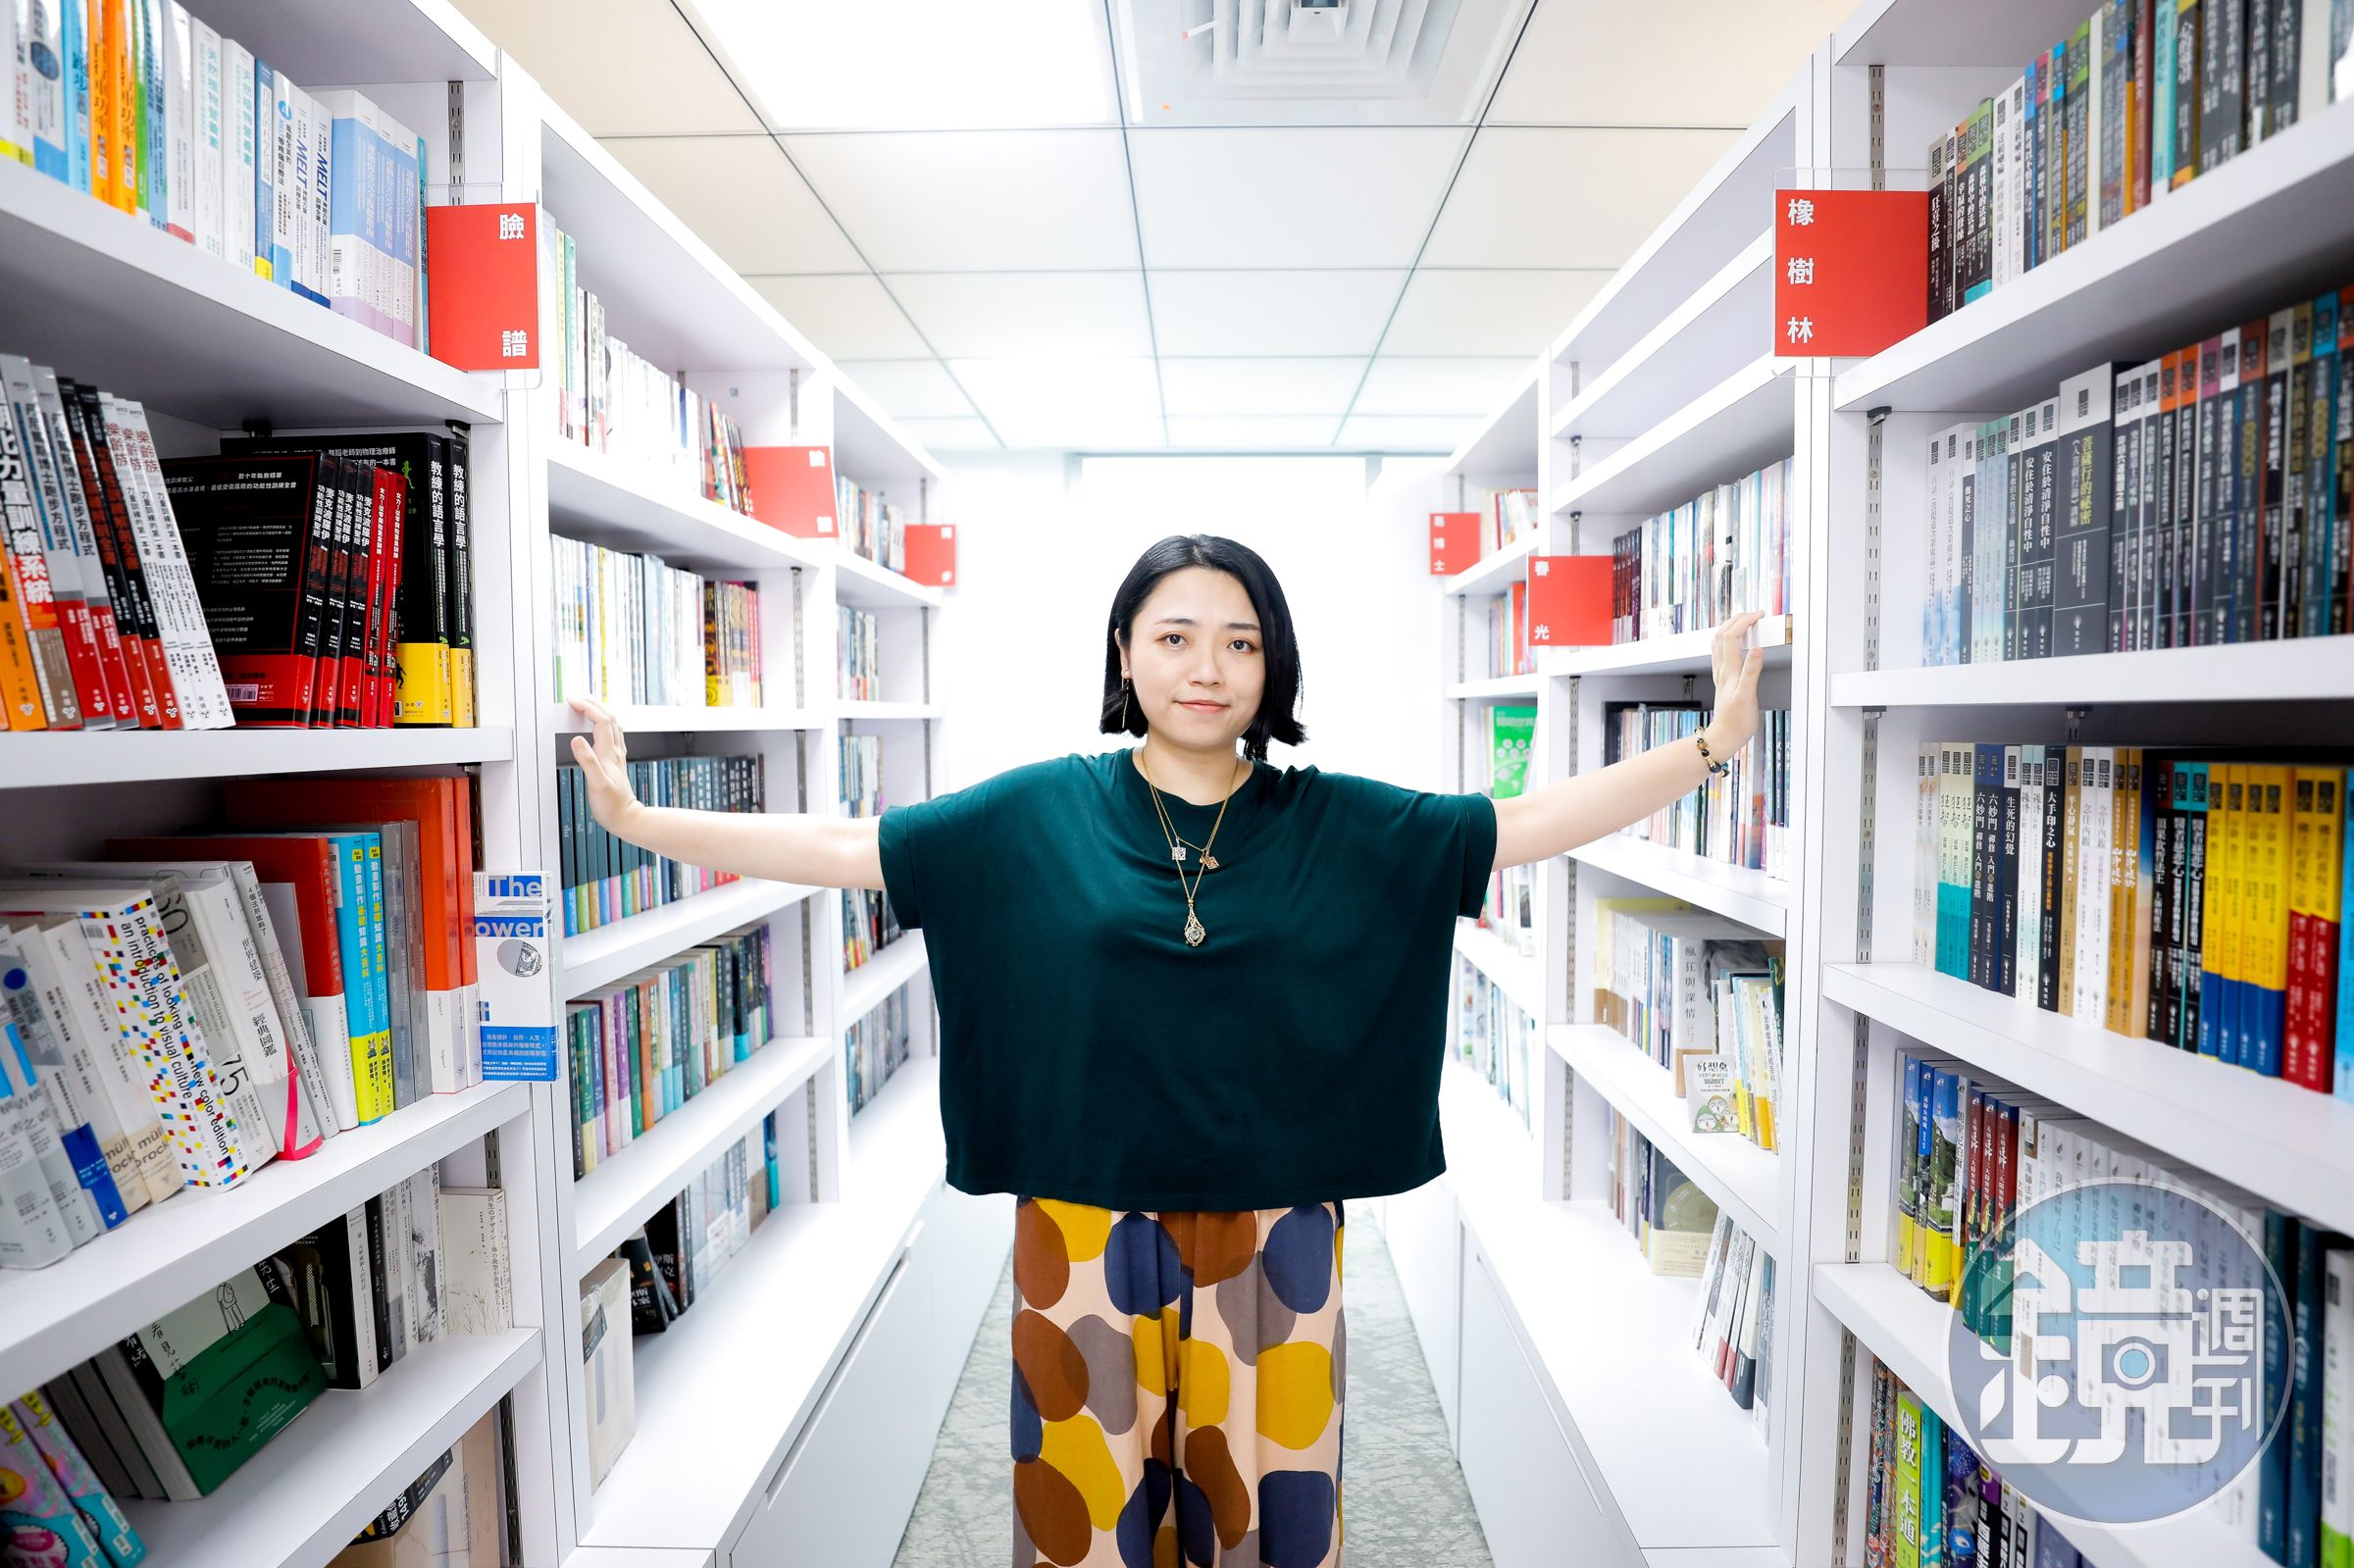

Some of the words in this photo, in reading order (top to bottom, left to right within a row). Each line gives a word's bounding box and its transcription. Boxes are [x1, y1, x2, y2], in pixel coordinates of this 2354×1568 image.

[294, 138, 309, 189] MELT
[315, 152, 330, 203] MELT
[1930, 195, 1941, 252] 狂喜之後
[499, 213, 529, 358] 臉譜
[1787, 198, 1815, 344] 橡樹林
[136, 430, 160, 474] 樂齡族
[127, 487, 151, 557] 力量訓練的第一本書
[141, 491, 166, 560] 力量訓練的第一本書
[320, 486, 336, 540] 麥克波羅伊
[341, 492, 355, 544] 麥克波羅伊
[361, 496, 374, 547] 麥克波羅伊
[431, 460, 445, 548] 教練的語言學
[452, 464, 467, 549] 教練的語言學
[2022, 456, 2035, 553] 安住於清淨自性中
[2039, 450, 2053, 550] 安住於清淨自性中
[157, 492, 182, 560] 力量訓練的第一本書
[1534, 560, 1551, 640] 春光
[1975, 792, 1986, 829] 六妙門
[1987, 793, 1999, 831] 六妙門
[2005, 795, 2017, 856] 生死的幻覺
[2045, 791, 2058, 848] 大手印之心
[1974, 852, 1983, 872] 入門
[1975, 832, 1984, 851] 禪修
[1987, 855, 1996, 876] 入門
[1988, 834, 1997, 854] 禪修
[489, 876, 542, 897] The
[121, 923, 134, 938] an
[134, 916, 161, 974] practices
[475, 921, 543, 937] ower
[127, 939, 160, 1010] introduction
[157, 972, 170, 986] of
[1684, 944, 1697, 1020] 瘋狂與深情
[153, 1010, 165, 1025] to
[162, 985, 183, 1030] looking
[159, 1026, 177, 1060] visual
[170, 1059, 193, 1100] culture
[191, 1060, 205, 1087] new
[198, 1089, 216, 1121] color
[210, 1118, 230, 1154] edition
[1900, 1408, 1917, 1546] 佛教一本通
